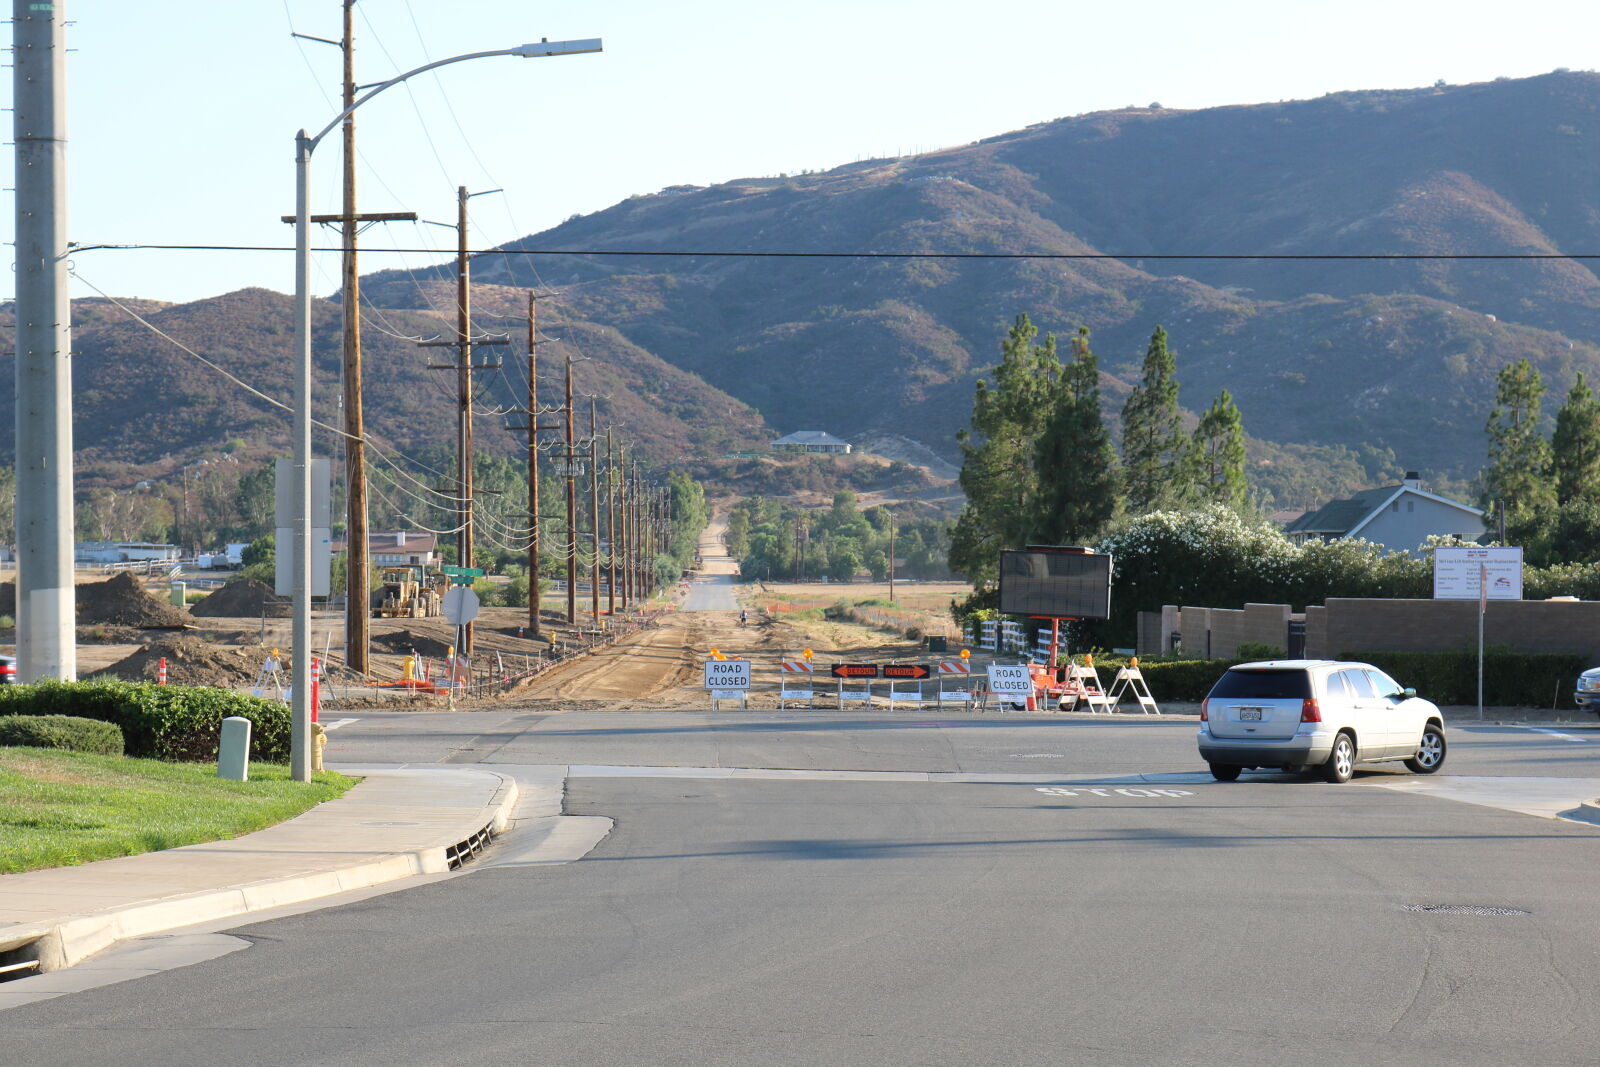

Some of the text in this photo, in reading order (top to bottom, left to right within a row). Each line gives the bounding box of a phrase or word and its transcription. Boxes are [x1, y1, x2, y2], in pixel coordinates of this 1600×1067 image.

[713, 664, 742, 674] ROAD
[847, 667, 874, 675] DETOUR
[996, 669, 1022, 678] ROAD
[708, 676, 747, 686] CLOSED
[993, 680, 1029, 690] CLOSED
[1034, 787, 1194, 798] STOP
